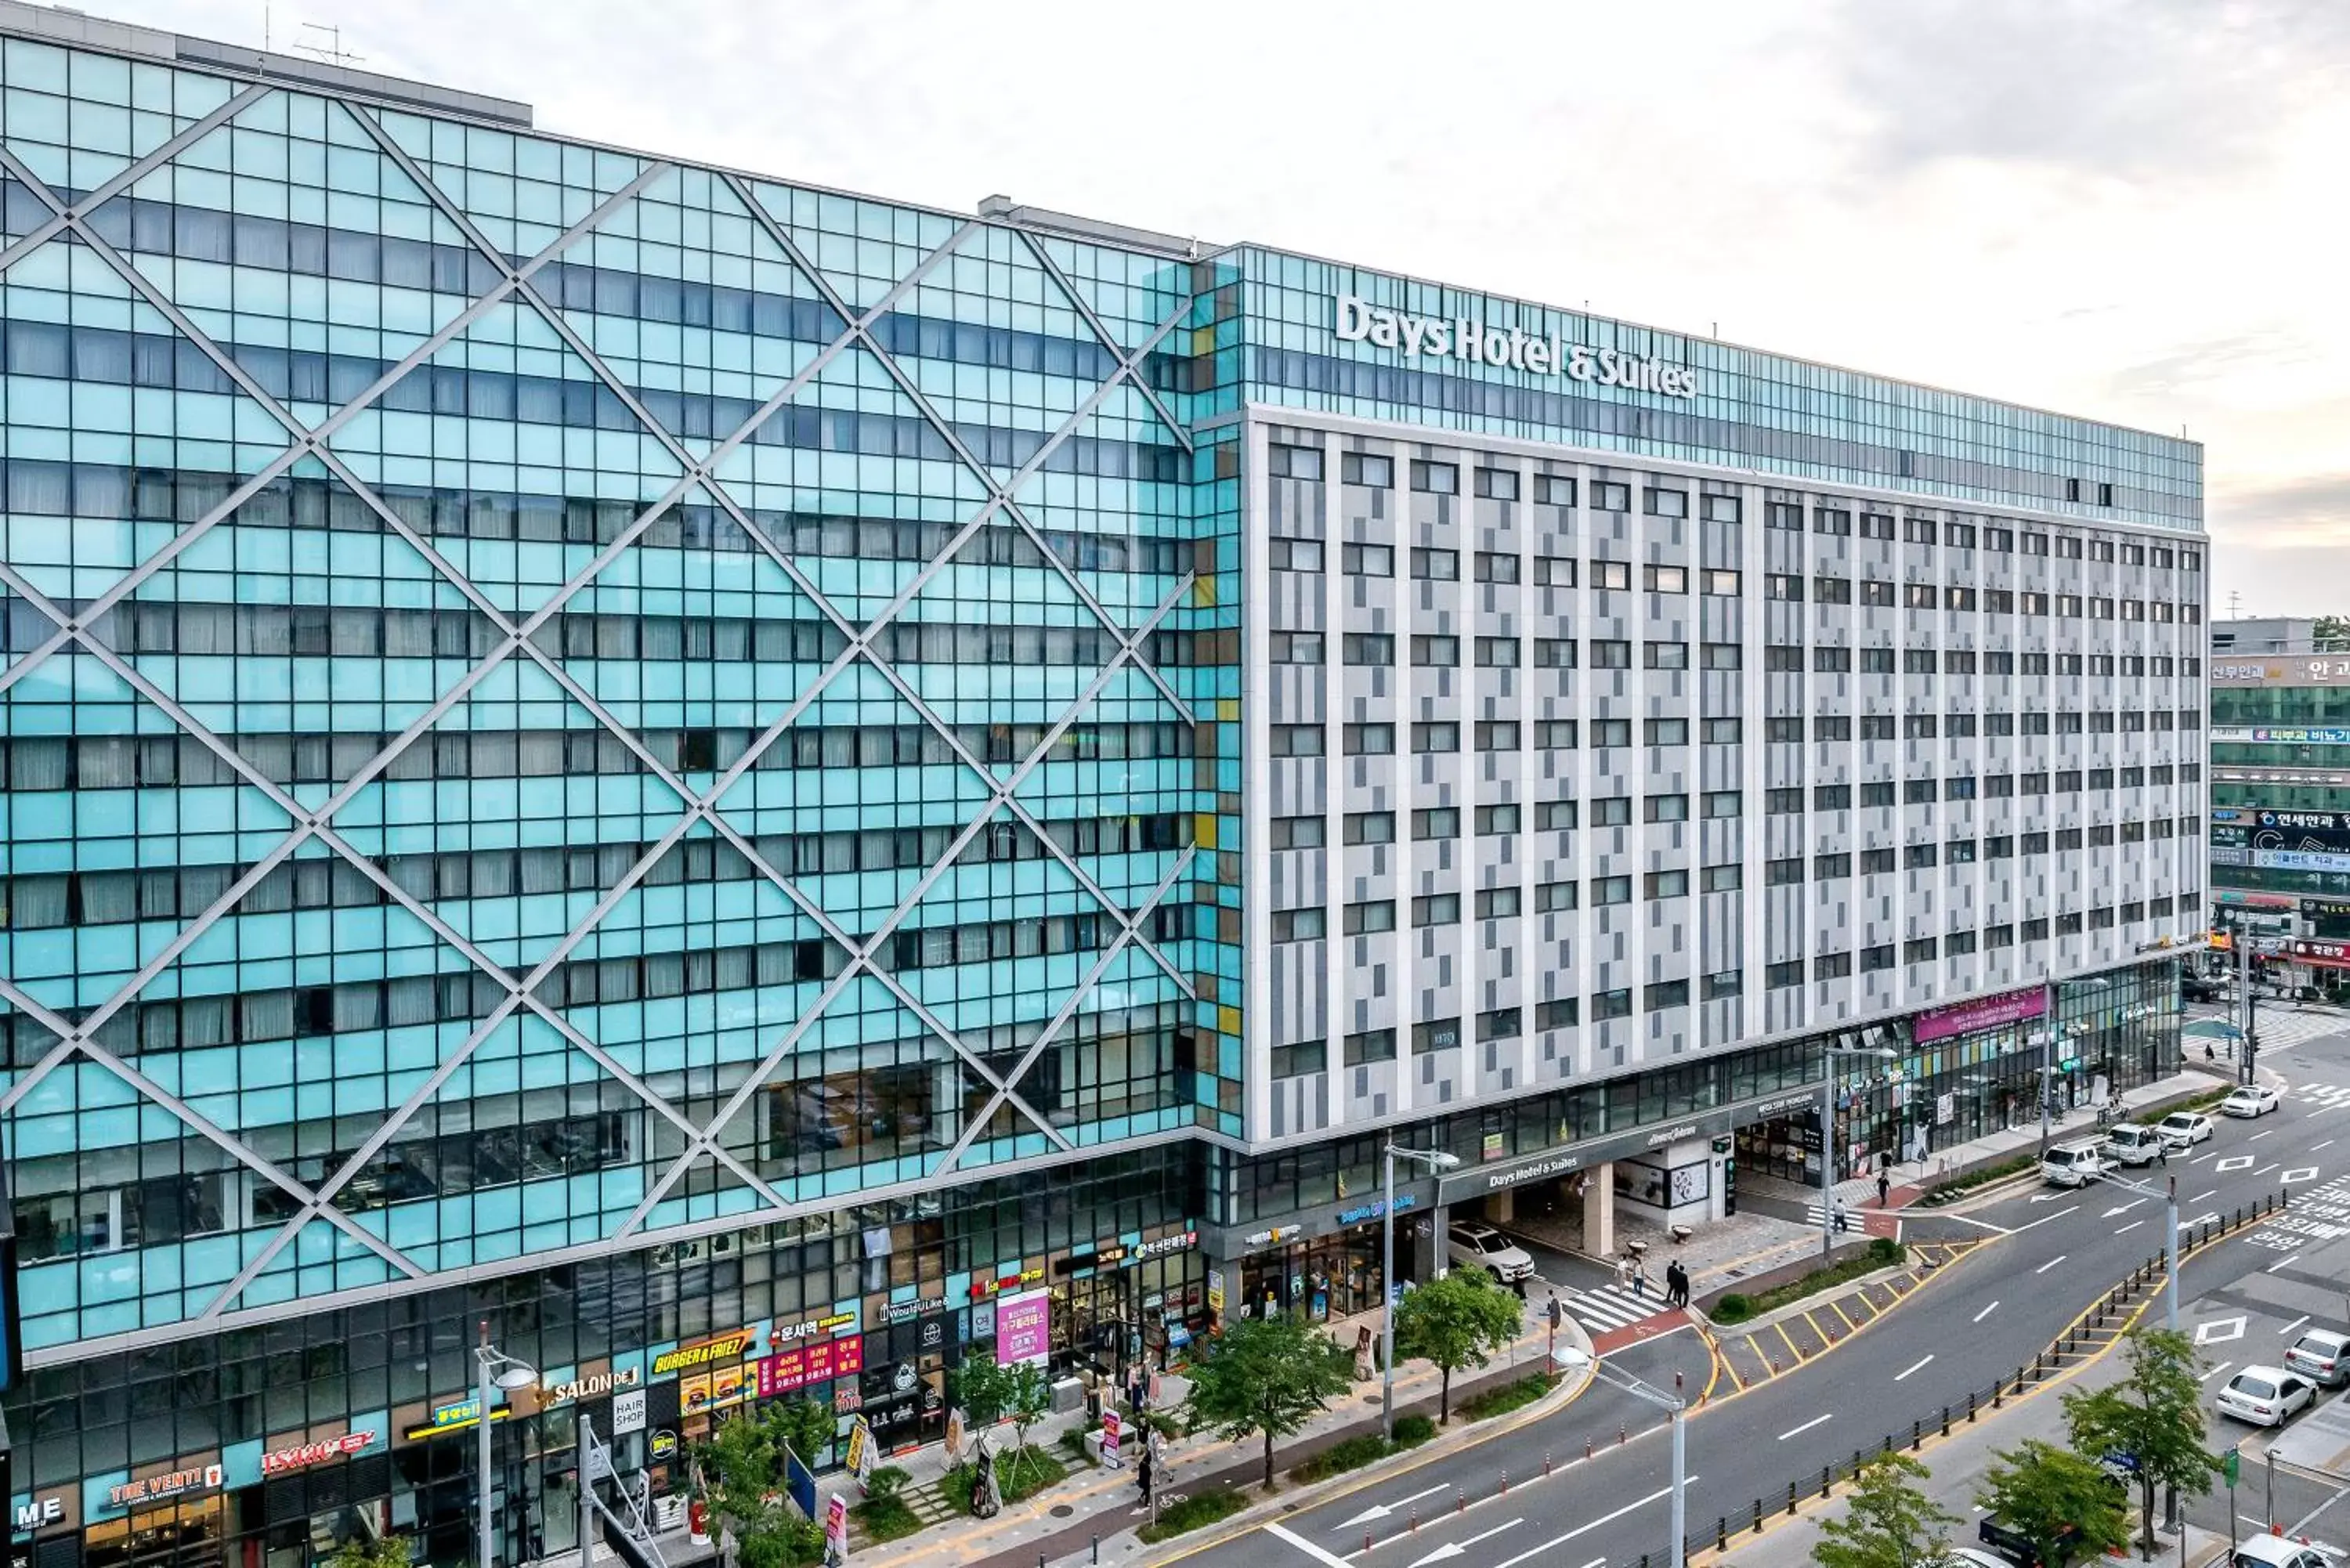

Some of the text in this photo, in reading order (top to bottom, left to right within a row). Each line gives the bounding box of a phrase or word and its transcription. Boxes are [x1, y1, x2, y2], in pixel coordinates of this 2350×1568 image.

[1336, 293, 1697, 399] Days Hotel & Suites
[2270, 729, 2307, 740] 피부과
[2278, 814, 2335, 828] 연세안과
[1490, 1172, 1515, 1189] Days
[1516, 1163, 1542, 1183] Hotel
[1550, 1157, 1578, 1175] Suites
[782, 1320, 817, 1342] 운서역
[655, 1348, 700, 1374] BURGER
[555, 1366, 638, 1402] SALON DE J
[616, 1400, 643, 1414] HAIR
[616, 1411, 643, 1427] SHOP
[111, 1468, 201, 1503] THE VENTI
